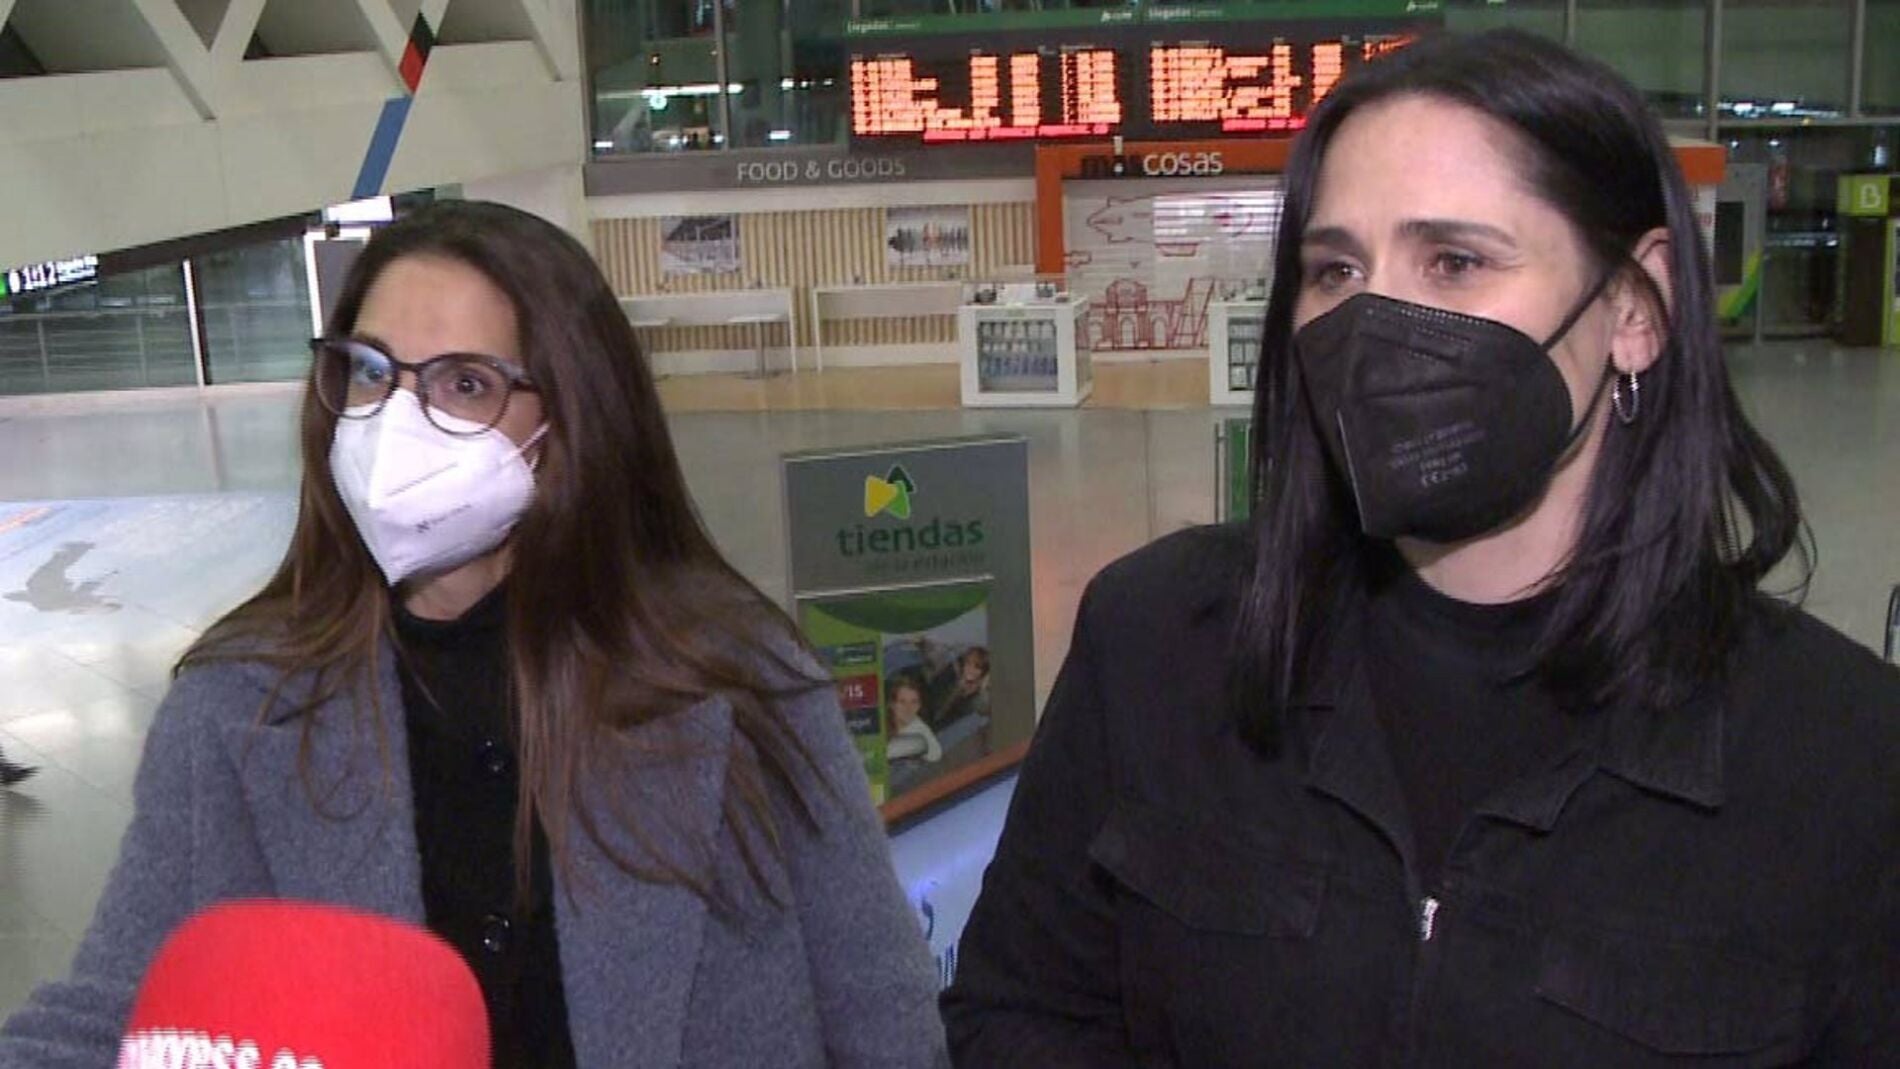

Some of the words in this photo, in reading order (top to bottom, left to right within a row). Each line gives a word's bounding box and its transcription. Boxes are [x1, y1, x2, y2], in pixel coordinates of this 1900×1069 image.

[736, 160, 799, 182] FOOD
[804, 159, 822, 180] &
[827, 157, 906, 179] GOODS
[1143, 151, 1224, 177] cosas
[836, 516, 985, 558] tiendas
